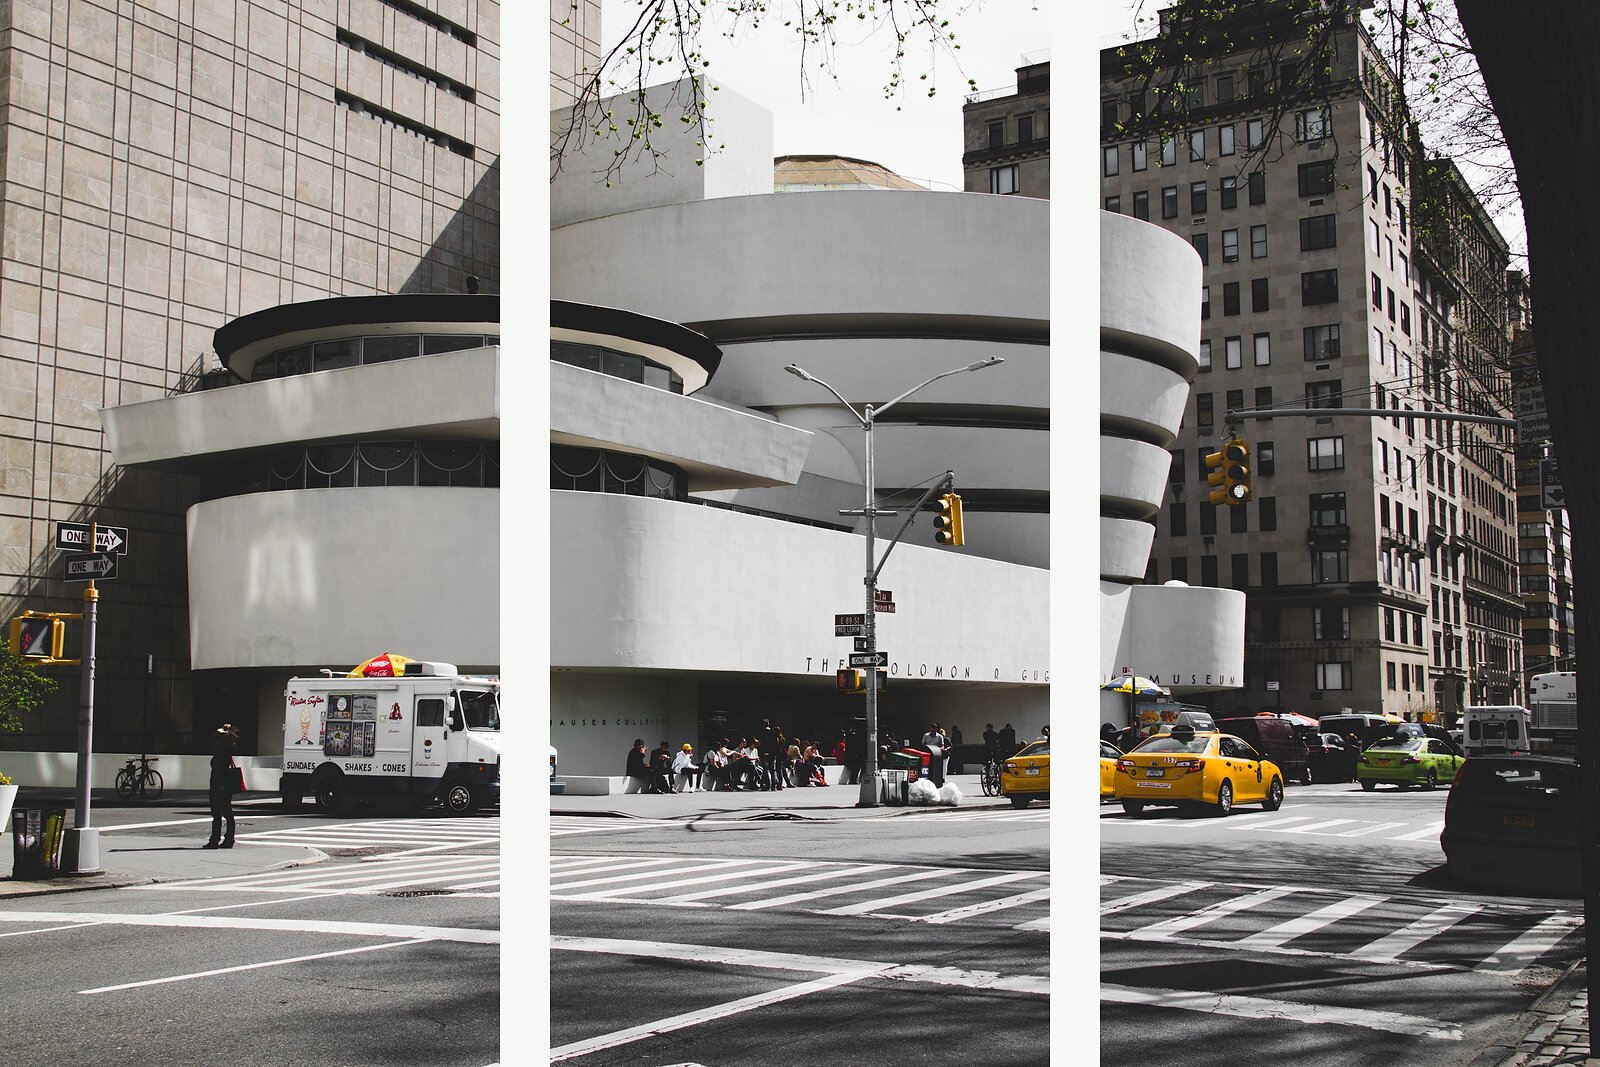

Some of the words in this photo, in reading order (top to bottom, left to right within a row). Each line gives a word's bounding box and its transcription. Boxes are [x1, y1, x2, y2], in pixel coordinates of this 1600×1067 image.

[1520, 392, 1530, 402] Big
[1531, 390, 1543, 400] Bus
[1520, 403, 1533, 413] New
[1535, 401, 1545, 410] Yor
[1521, 429, 1551, 443] Sightsee
[1547, 475, 1561, 483] BU
[66, 531, 87, 543] ONE
[96, 534, 117, 545] WAY
[71, 561, 87, 573] ONE
[93, 560, 109, 571] WAY
[840, 617, 845, 625] E
[845, 616, 853, 625] 89
[890, 662, 970, 679] OLOMON
[993, 668, 999, 680] R
[1149, 674, 1236, 685] MUSEUM
[286, 761, 316, 771] SUNDAES
[344, 763, 372, 772] SHAKES
[382, 763, 406, 773] CONES
